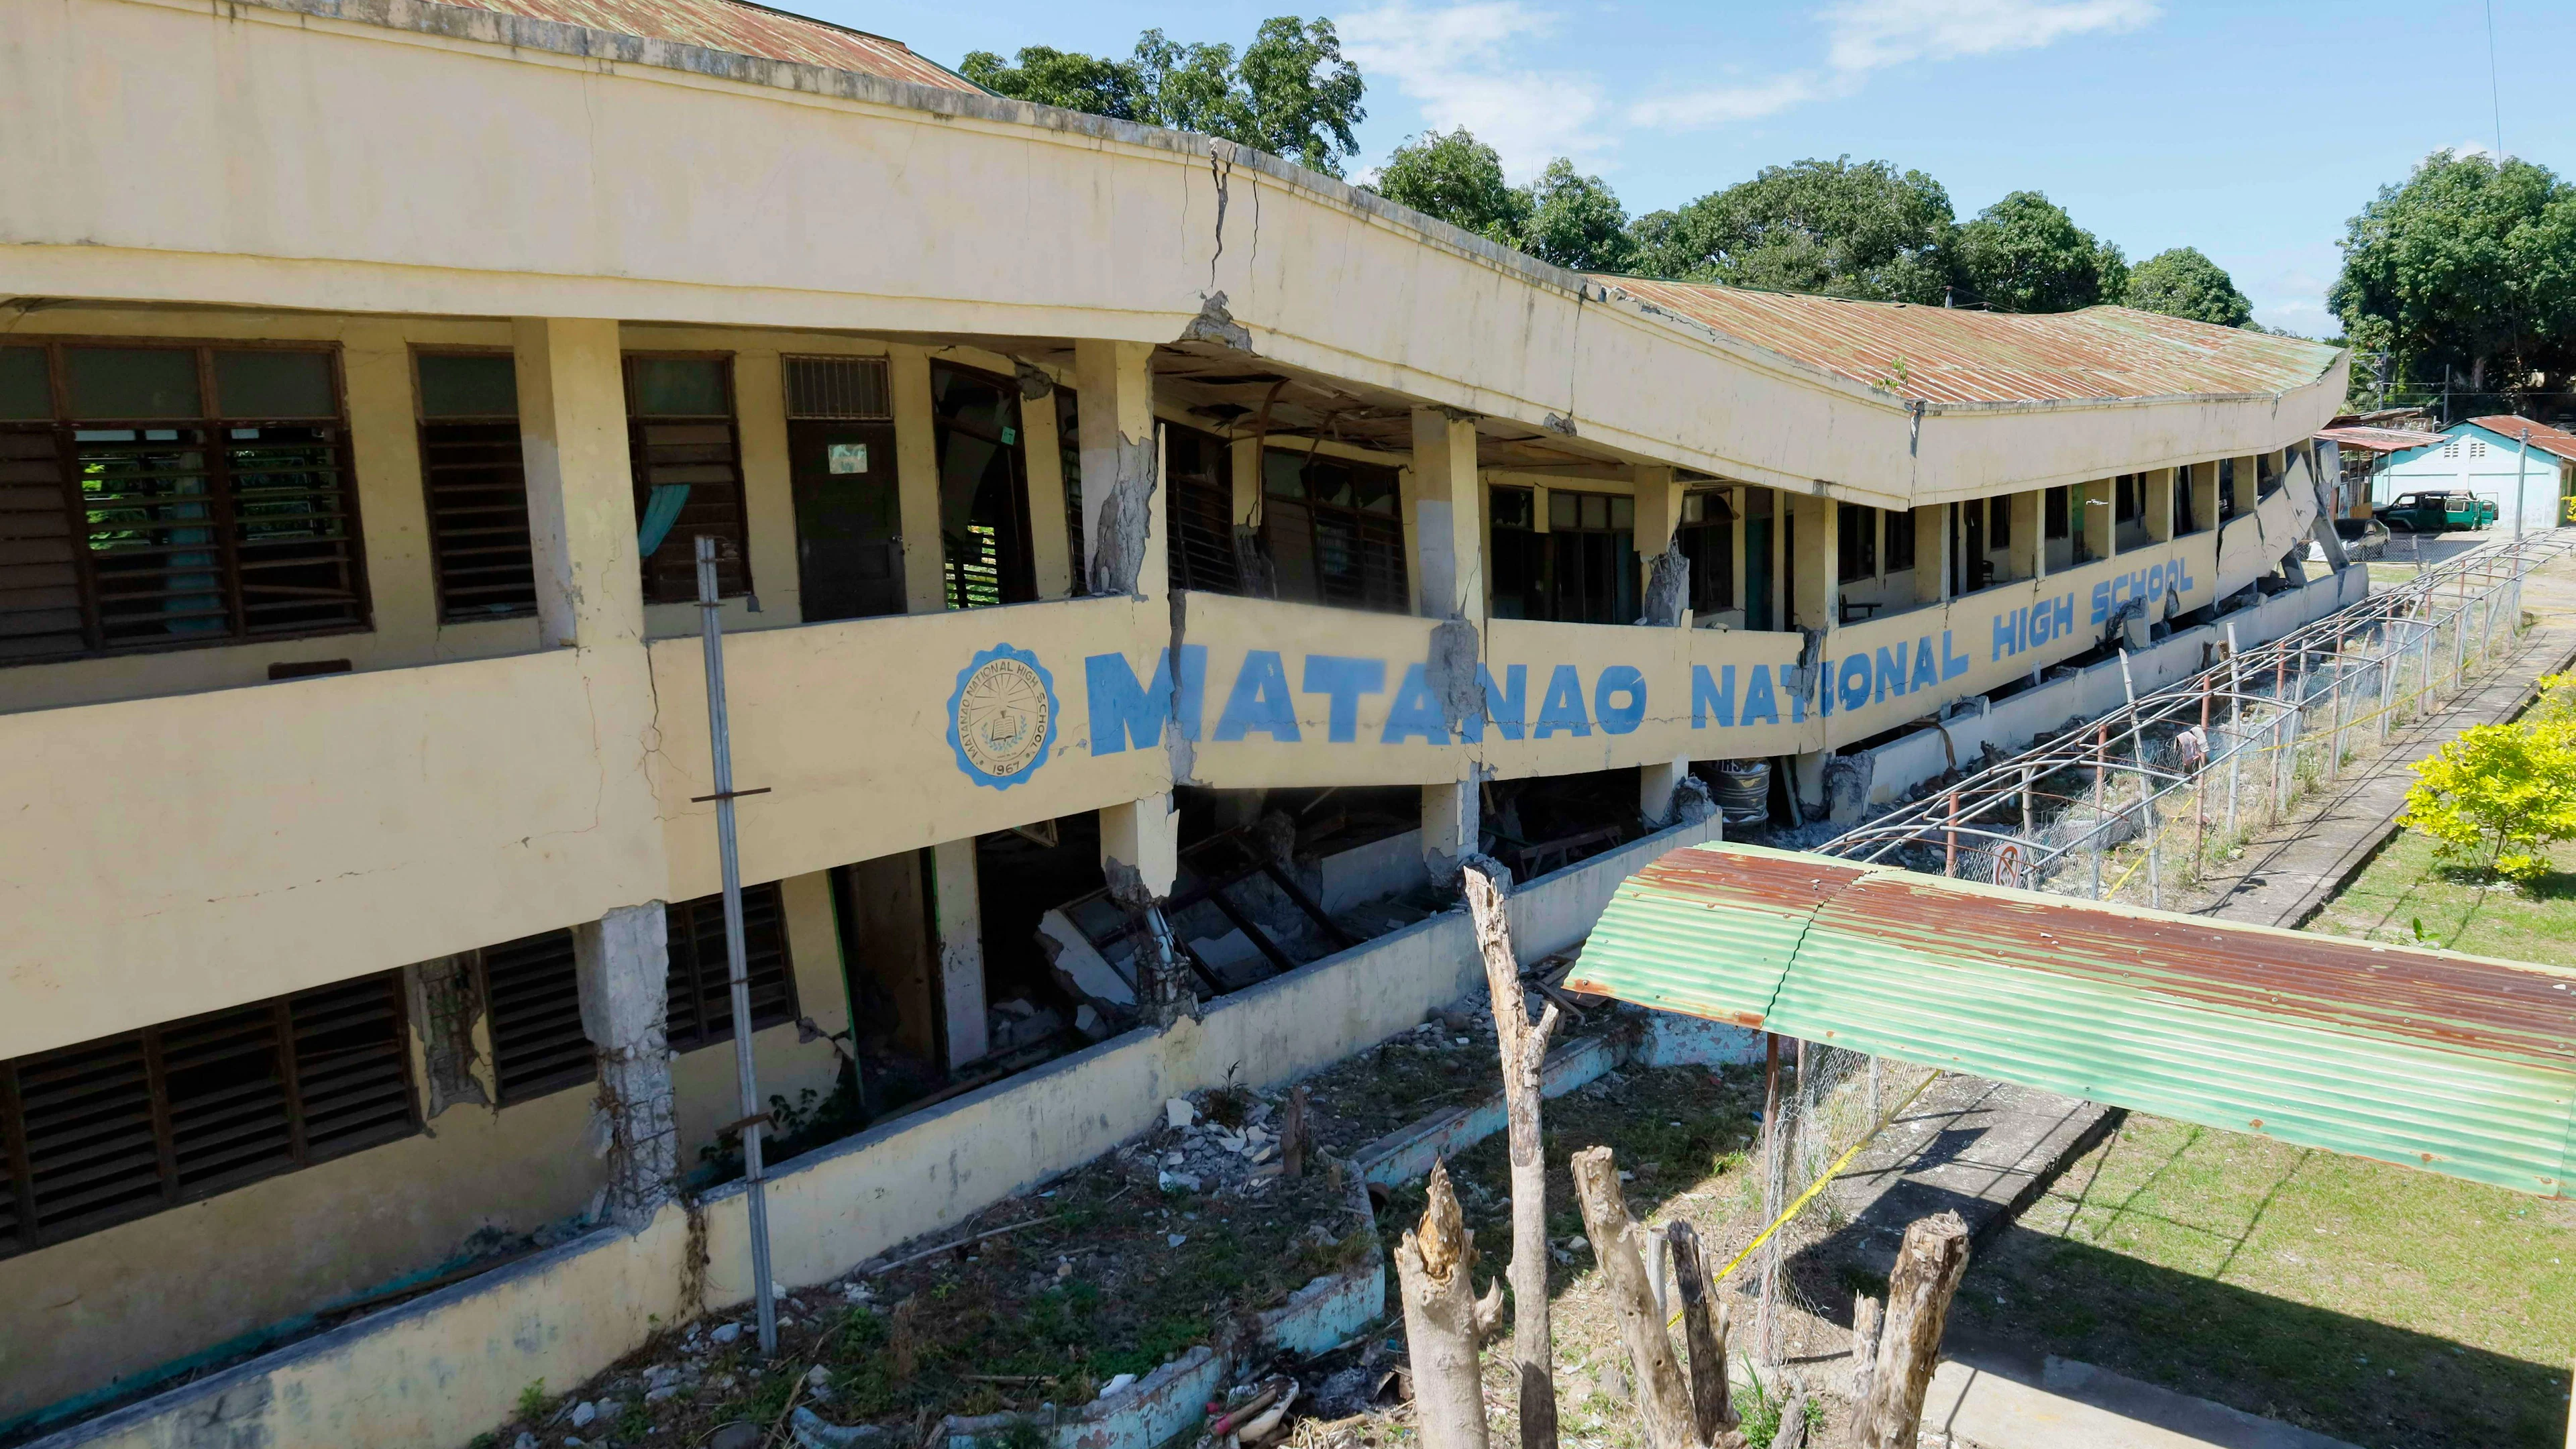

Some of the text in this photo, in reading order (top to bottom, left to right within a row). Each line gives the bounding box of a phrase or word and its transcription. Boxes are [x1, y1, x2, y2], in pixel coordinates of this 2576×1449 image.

[1085, 644, 1648, 757] MATANAO
[1992, 593, 2074, 661] HIGH
[2090, 557, 2194, 625] SCHOOL
[960, 661, 1046, 759] MATANAO NATIONAL HIGH SCHOOL
[993, 761, 1020, 775] 1967
